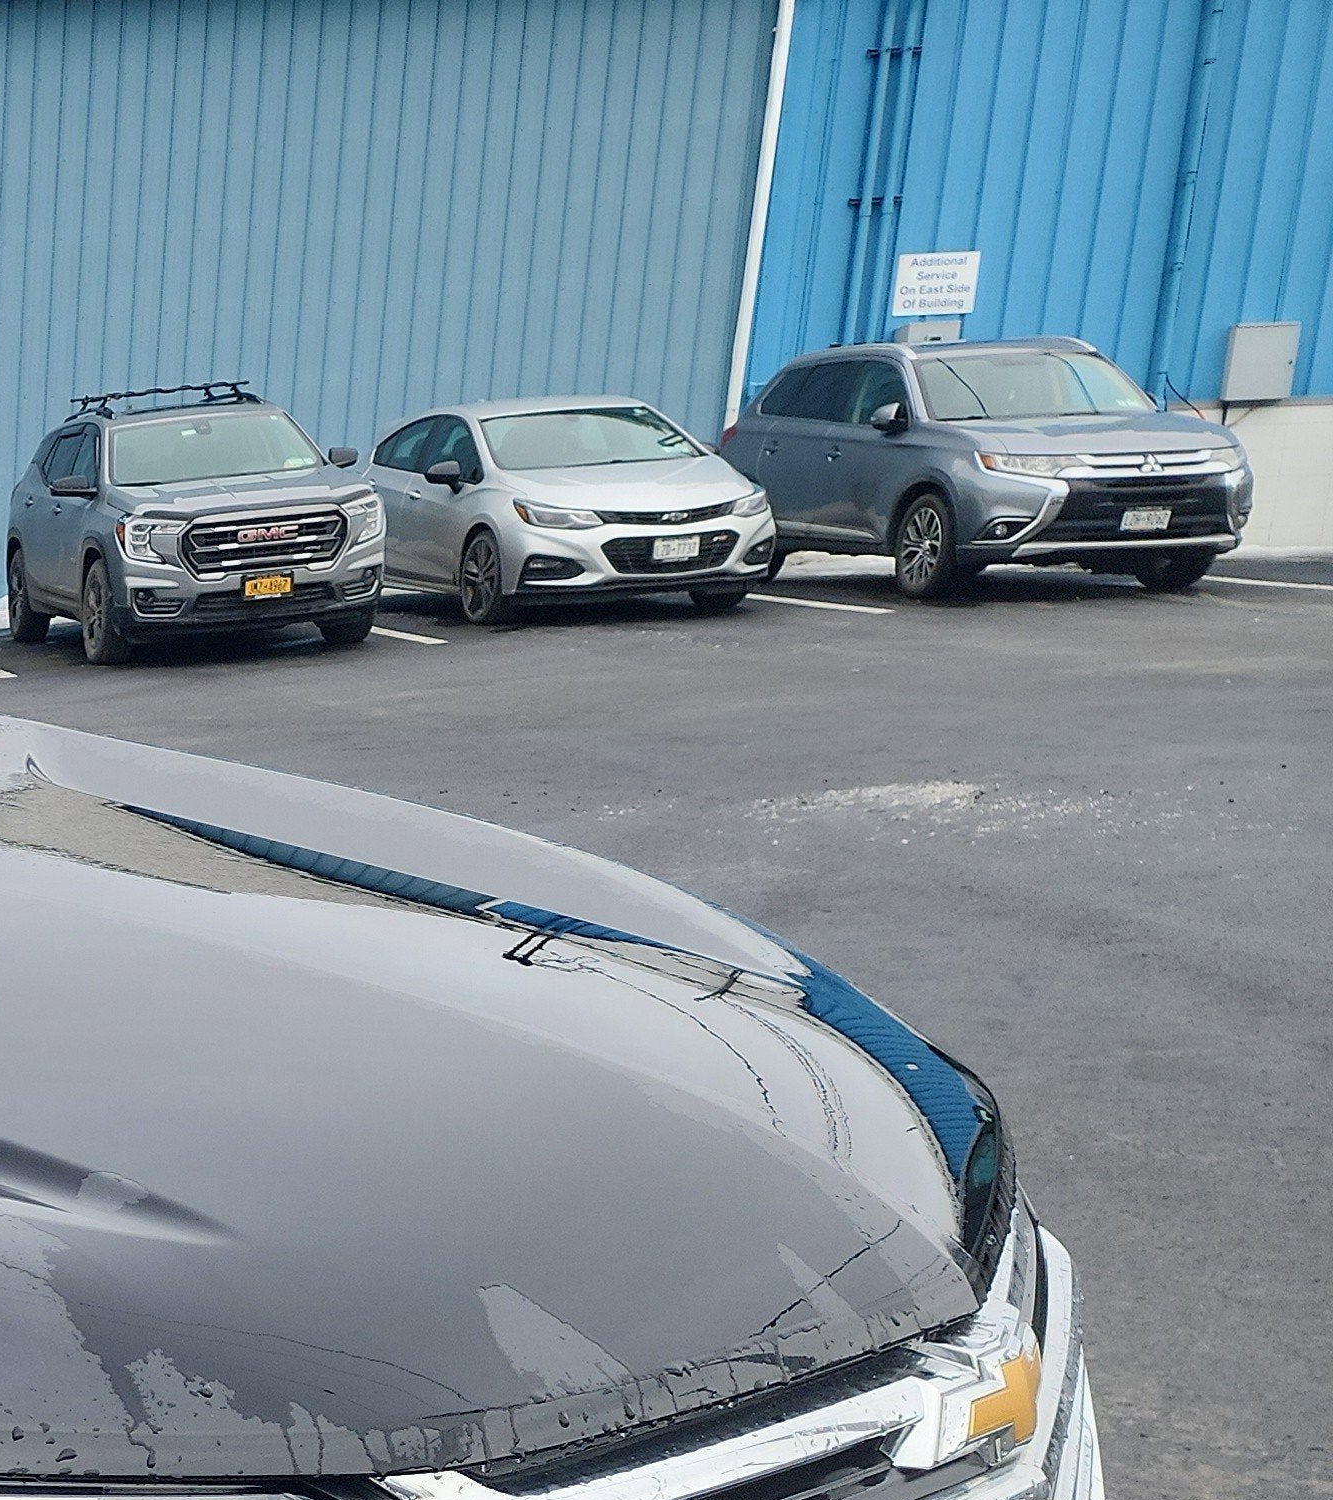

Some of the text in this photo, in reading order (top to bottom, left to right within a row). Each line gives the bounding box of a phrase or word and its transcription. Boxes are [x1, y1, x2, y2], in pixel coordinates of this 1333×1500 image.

[910, 256, 968, 267] Additional
[916, 270, 958, 281] Service
[899, 283, 971, 295] On East Side
[902, 297, 965, 310] Of Building
[237, 525, 299, 543] GMC
